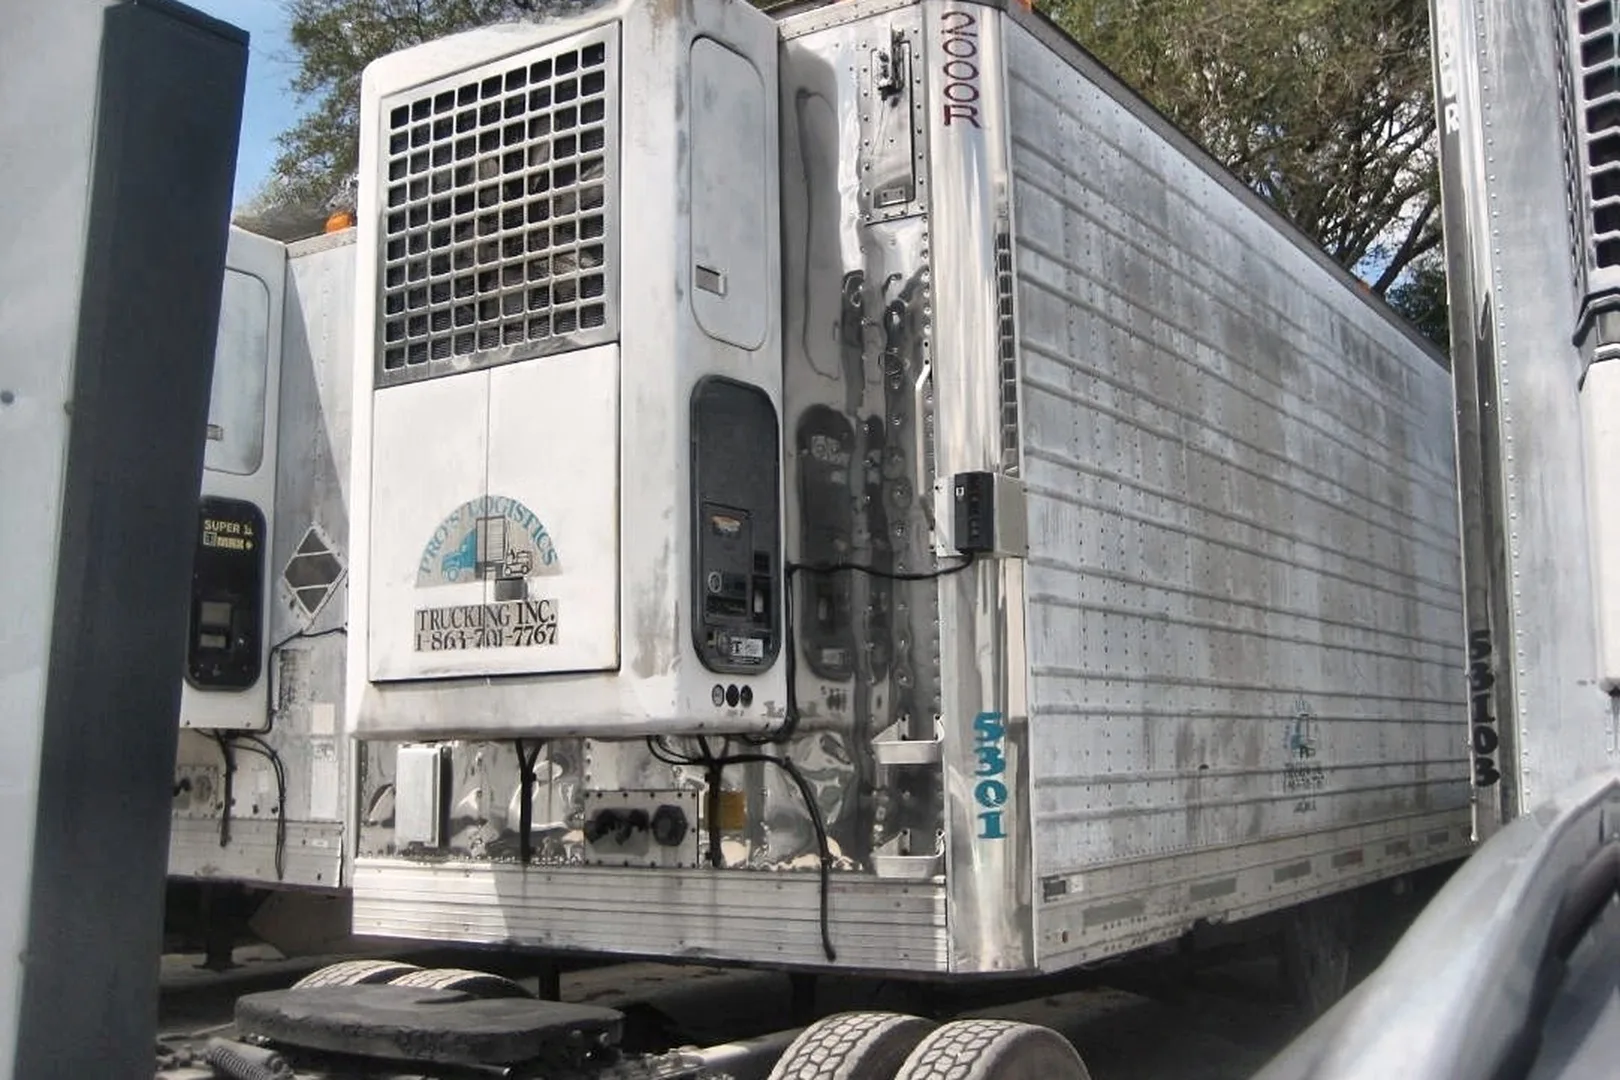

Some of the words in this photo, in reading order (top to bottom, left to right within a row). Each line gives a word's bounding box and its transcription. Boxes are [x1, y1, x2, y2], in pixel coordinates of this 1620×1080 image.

[941, 11, 980, 128] 2000R
[204, 519, 241, 534] SUPER
[466, 496, 558, 567] LOGISTICS
[416, 603, 510, 631] TRUCKING
[516, 600, 555, 625] INC.
[973, 712, 1007, 839] 5301
